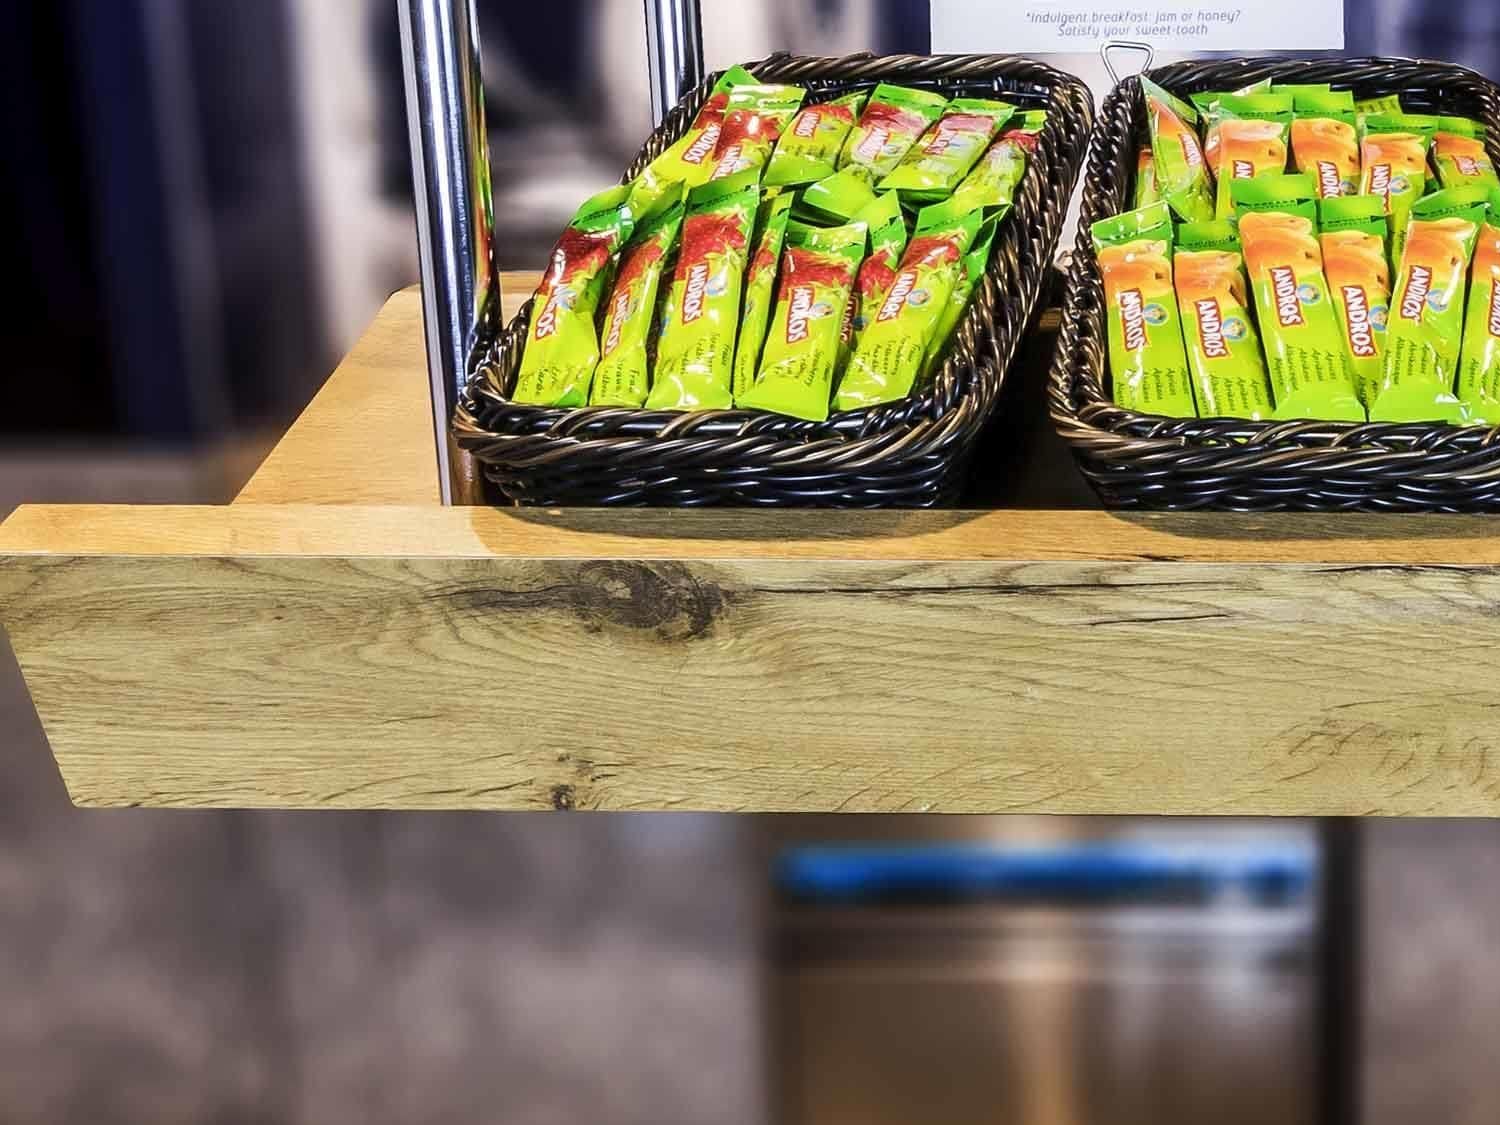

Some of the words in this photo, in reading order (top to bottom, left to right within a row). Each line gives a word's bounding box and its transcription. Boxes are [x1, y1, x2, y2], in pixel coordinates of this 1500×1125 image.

[1197, 10, 1242, 24] honey?
[1269, 268, 1304, 326] ANDROS
[1341, 287, 1376, 356] ANDROS
[1402, 267, 1430, 320] ANDROS
[1196, 299, 1230, 357] ANDROS
